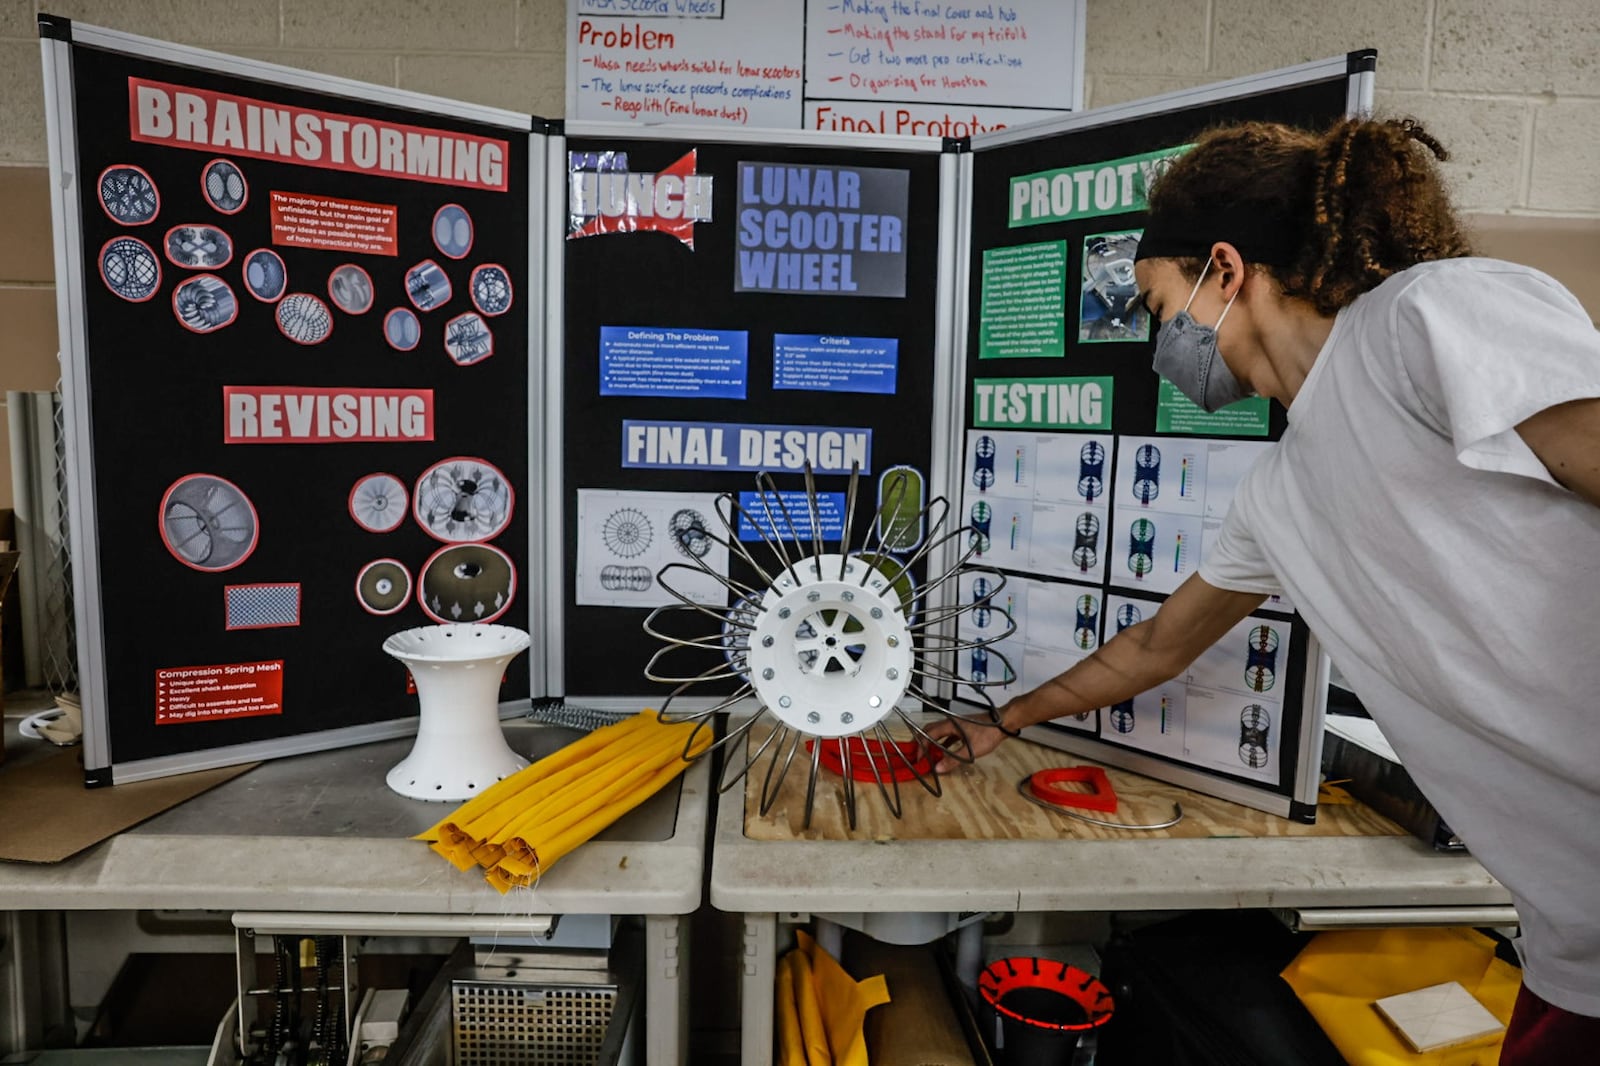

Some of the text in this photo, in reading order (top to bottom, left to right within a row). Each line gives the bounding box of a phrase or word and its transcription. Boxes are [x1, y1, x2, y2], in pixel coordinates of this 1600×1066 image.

[579, 21, 674, 50] Problem
[592, 77, 791, 100] The lunar surface presents complications
[614, 96, 662, 119] Regolith
[817, 107, 884, 134] Final
[137, 86, 503, 186] BRAINSTORMING
[571, 173, 712, 219] HUNCH
[743, 167, 861, 209] LUNAR
[273, 194, 287, 202] The
[289, 198, 319, 207] majority
[350, 205, 381, 214] concepts
[275, 225, 296, 233] many
[298, 226, 316, 234] ideas
[328, 230, 356, 238] possible
[358, 234, 392, 242] regardless
[299, 218, 319, 226] stage
[739, 209, 902, 253] SCOOTER
[313, 238, 352, 247] impractical
[740, 251, 857, 291] WHEEL
[628, 332, 719, 341] Defining The Problem
[977, 382, 1102, 424] TESTING
[230, 394, 425, 438] REVISING
[628, 426, 866, 470] FINAL DESIGN
[160, 663, 280, 678] Compression Spring Mesh
[222, 682, 256, 690] absorption
[224, 706, 247, 714] ground
